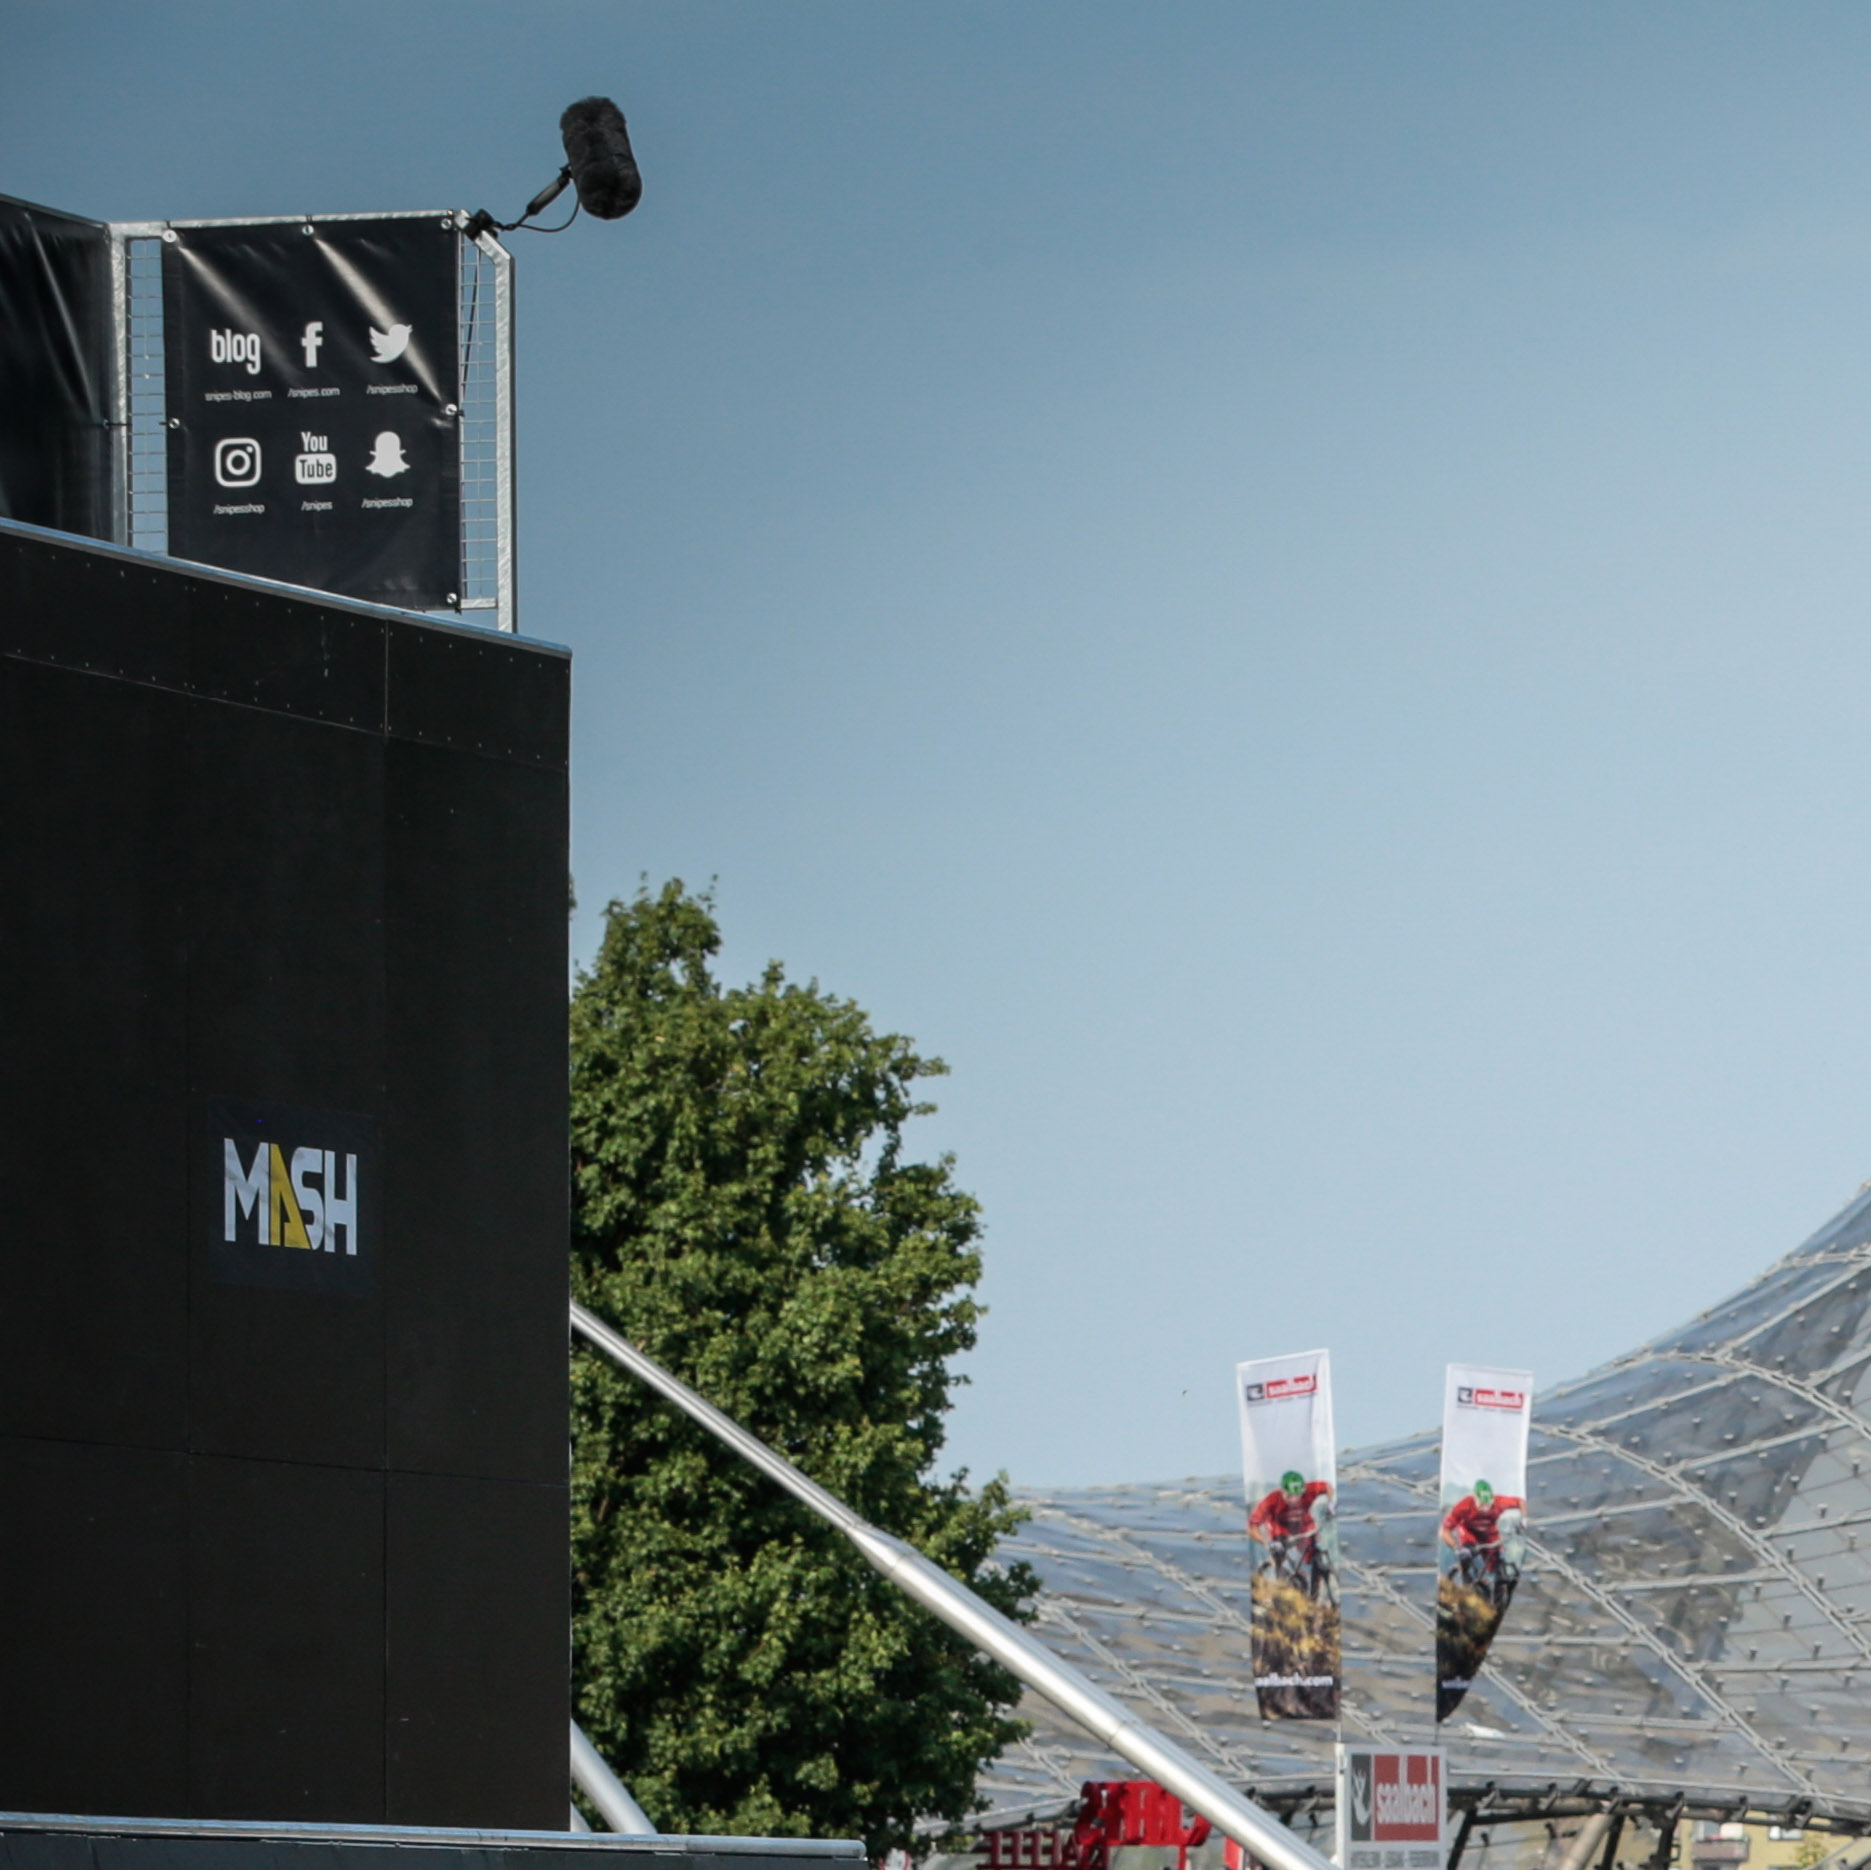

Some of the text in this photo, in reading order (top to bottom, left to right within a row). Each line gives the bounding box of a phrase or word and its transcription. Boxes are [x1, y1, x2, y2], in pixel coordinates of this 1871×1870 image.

[211, 329, 261, 374] blog
[301, 432, 328, 452] You
[300, 459, 333, 479] Tube
[224, 1138, 357, 1256] MASH
